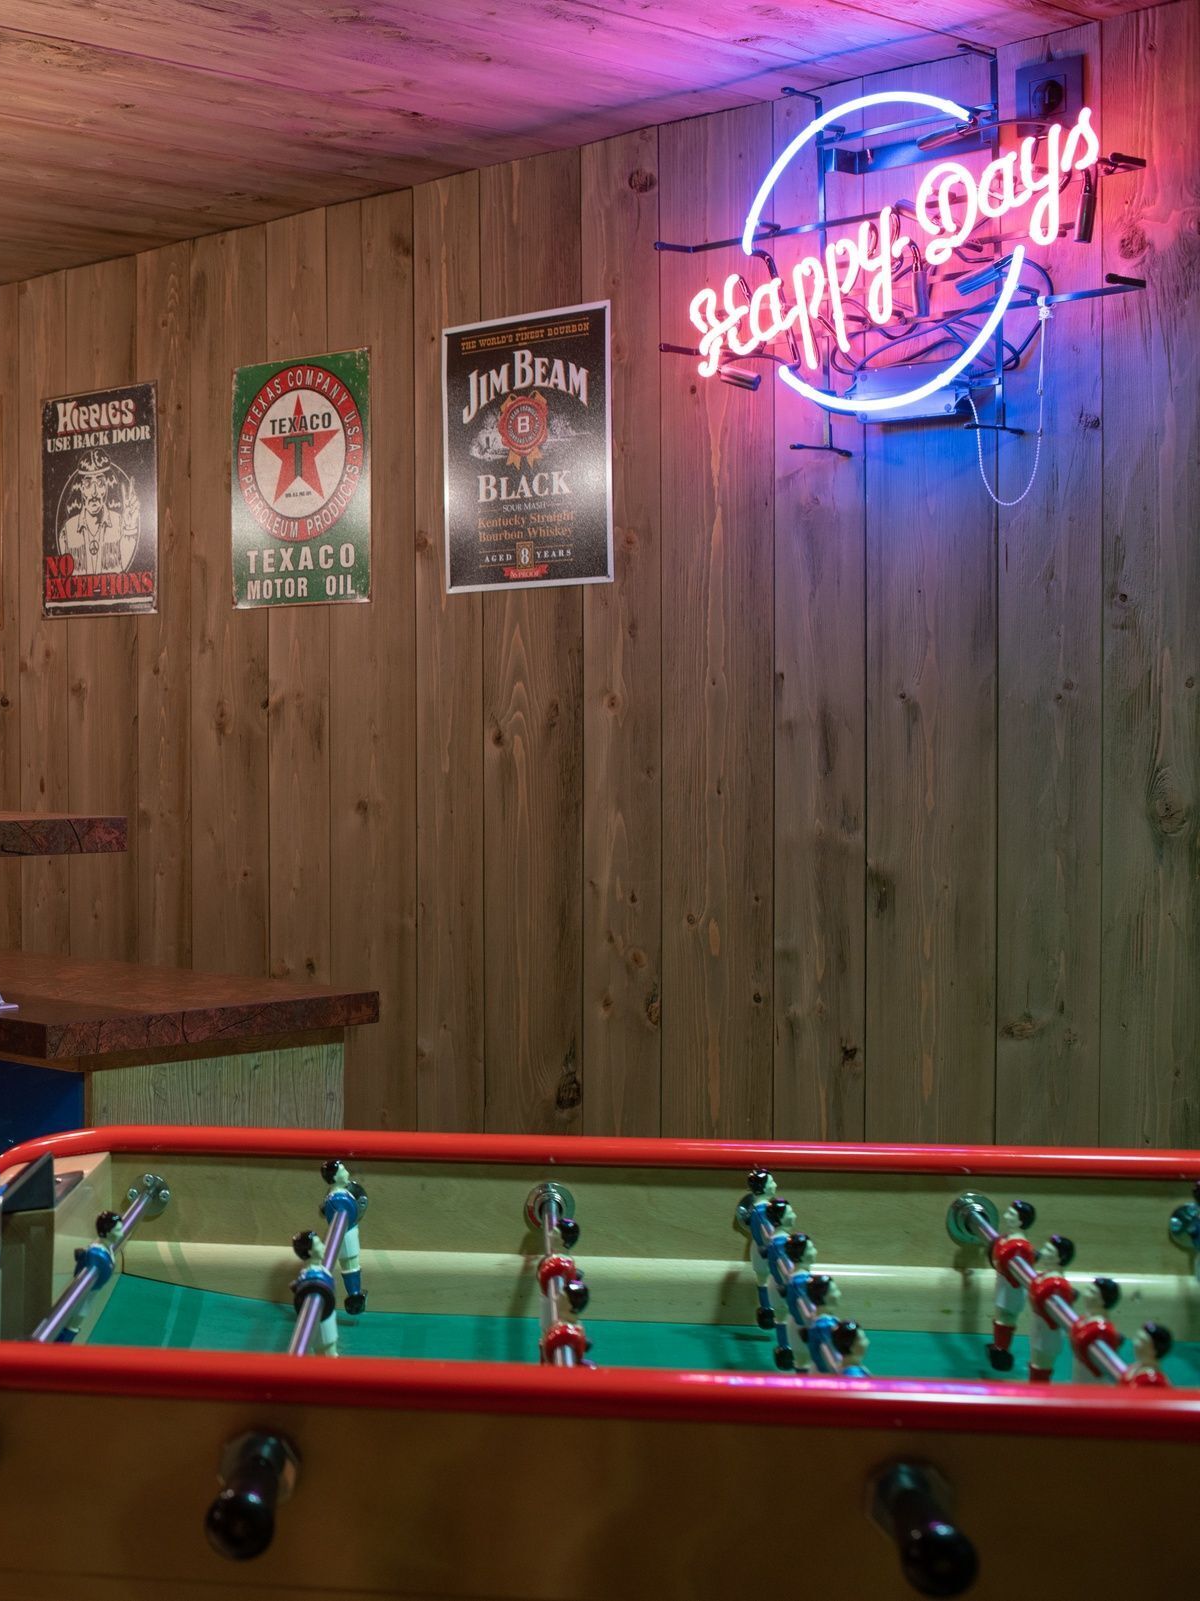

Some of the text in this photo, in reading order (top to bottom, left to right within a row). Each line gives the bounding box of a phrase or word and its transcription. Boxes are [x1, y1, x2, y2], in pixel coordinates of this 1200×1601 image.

[689, 106, 1099, 377] Happy Days
[460, 322, 590, 350] THE WORLD'S FINEST BOURBON
[56, 398, 136, 435] HIPPIES
[239, 433, 253, 465] THE
[248, 377, 282, 426] TEXAS
[287, 367, 349, 406] COMPANY
[269, 411, 332, 435] TEXACO
[47, 425, 151, 453] USE BACK DOOR
[477, 469, 573, 502] BLACK
[241, 464, 359, 538] PETROLEUM PRODUCTS
[477, 511, 574, 529] Kentucky Straight
[478, 525, 572, 542] Bourbon Whiskey
[46, 554, 75, 577] NO
[246, 542, 356, 574] TEXACO
[484, 547, 572, 565] AGED 8 YEARS
[46, 572, 155, 599] EXCEPTIONS
[246, 573, 356, 601] MOTOR OIL
